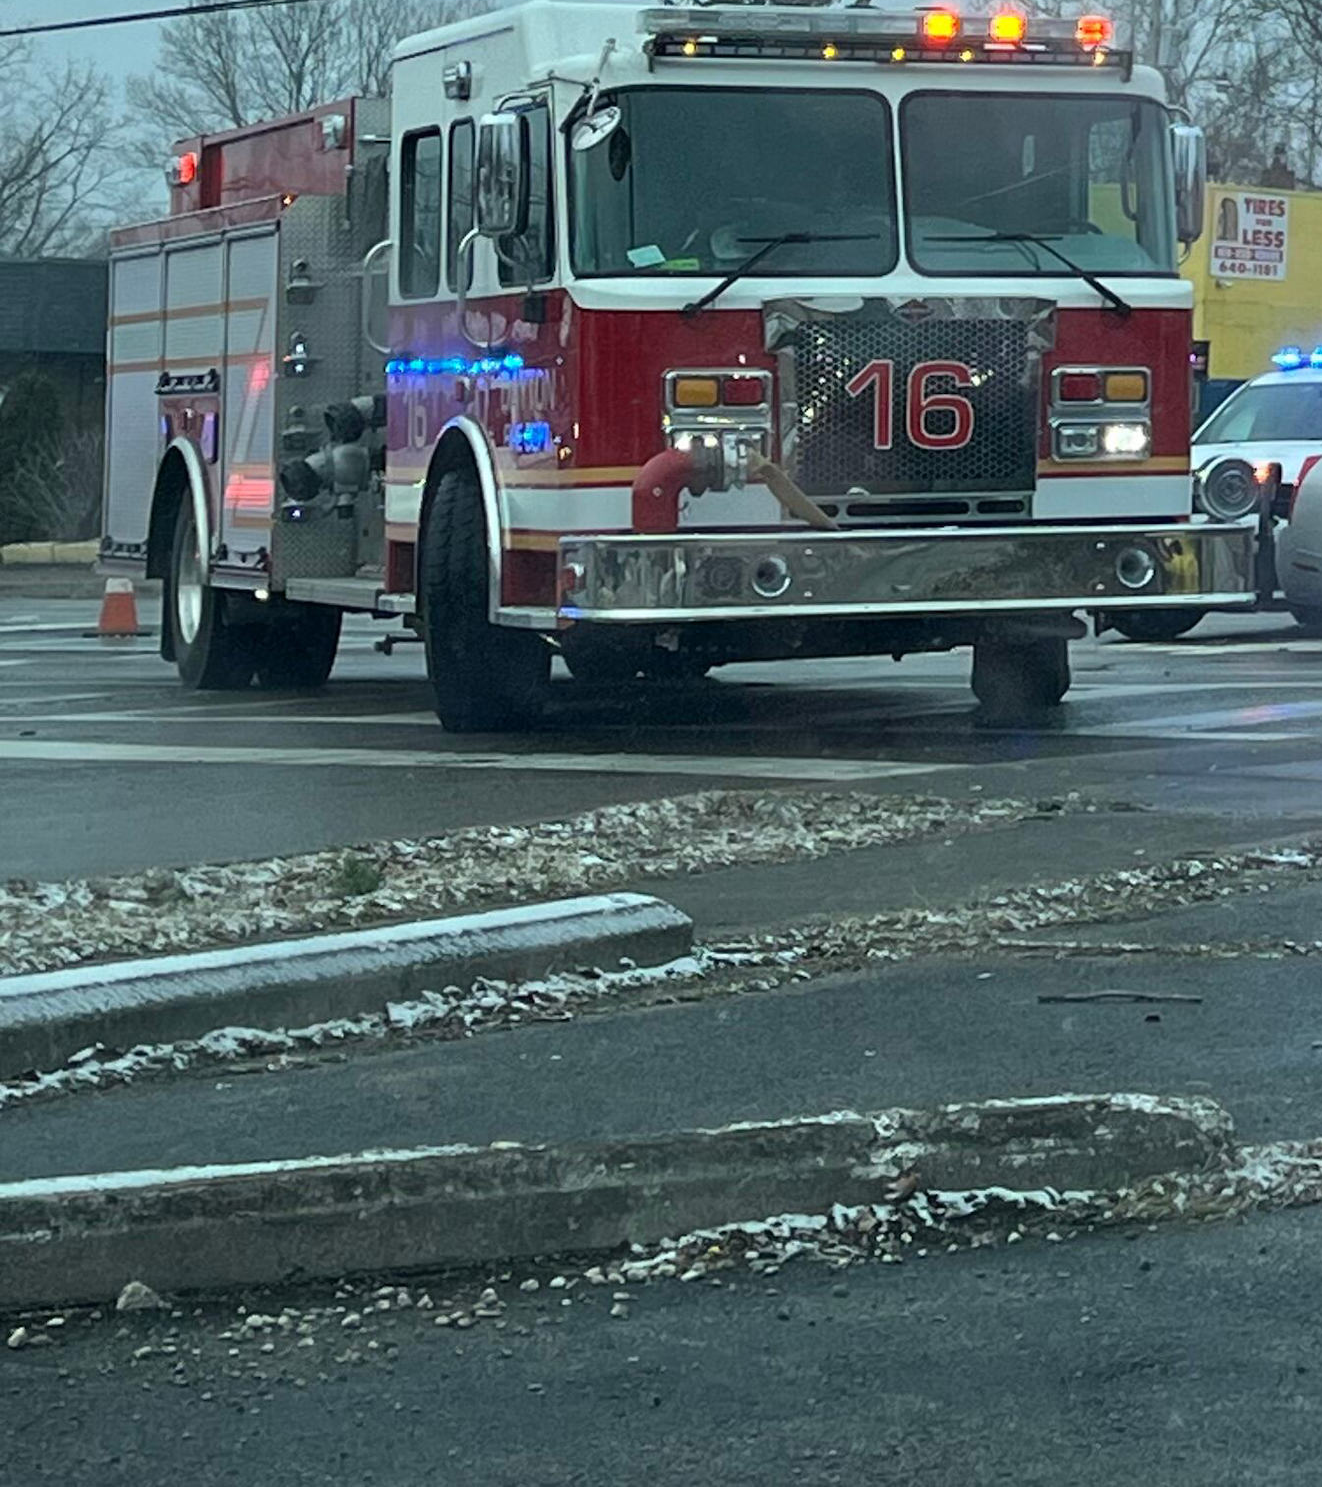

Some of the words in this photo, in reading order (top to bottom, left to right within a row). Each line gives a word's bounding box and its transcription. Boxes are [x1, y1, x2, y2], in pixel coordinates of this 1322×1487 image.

[1244, 197, 1286, 217] TIRES
[1242, 228, 1284, 248] LESS
[845, 359, 974, 449] 16
